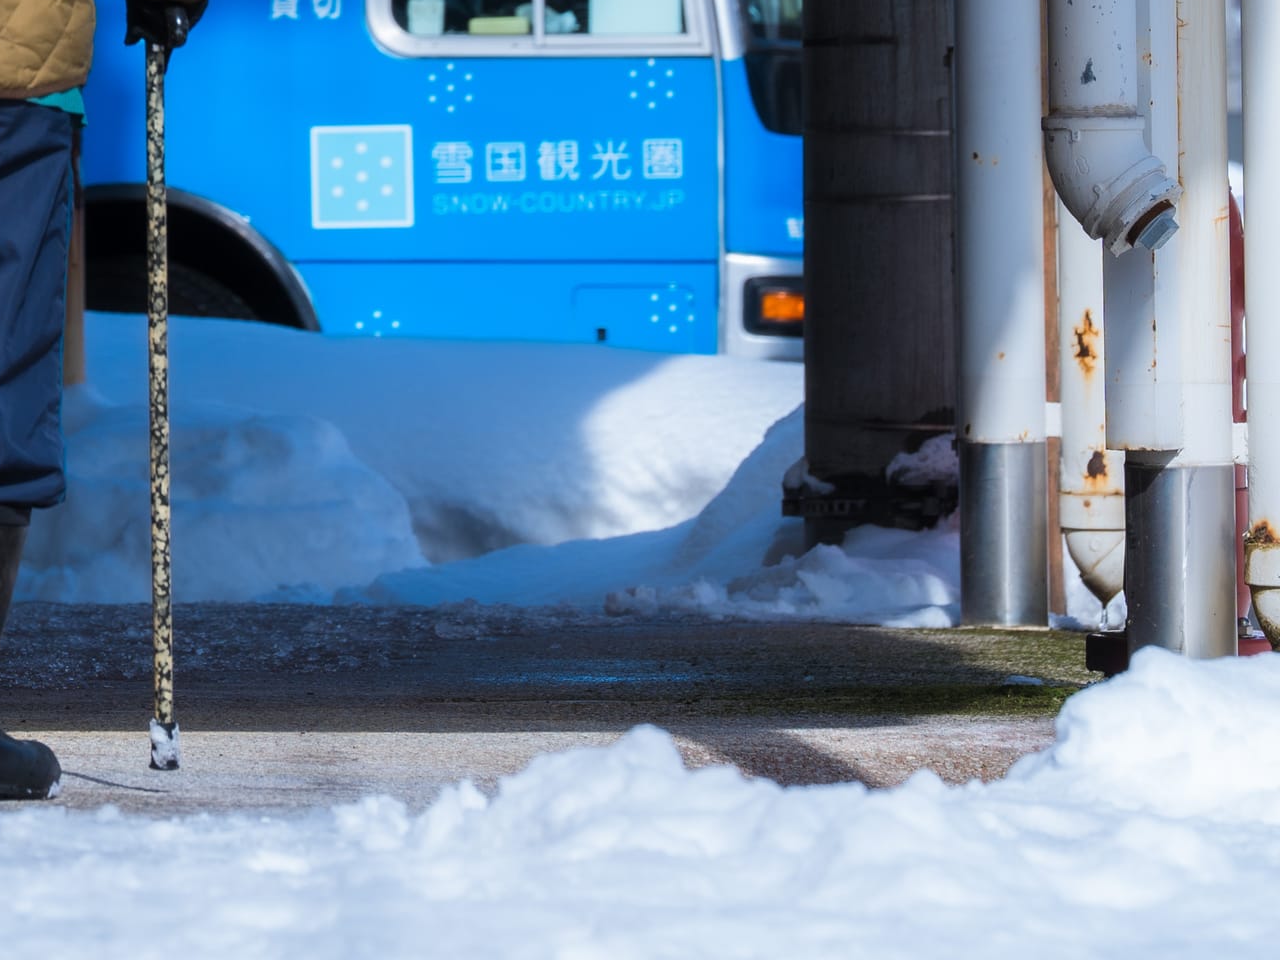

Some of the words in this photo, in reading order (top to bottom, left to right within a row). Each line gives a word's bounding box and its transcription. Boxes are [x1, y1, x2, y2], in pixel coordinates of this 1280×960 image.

[431, 138, 684, 183] 雪国観光圏
